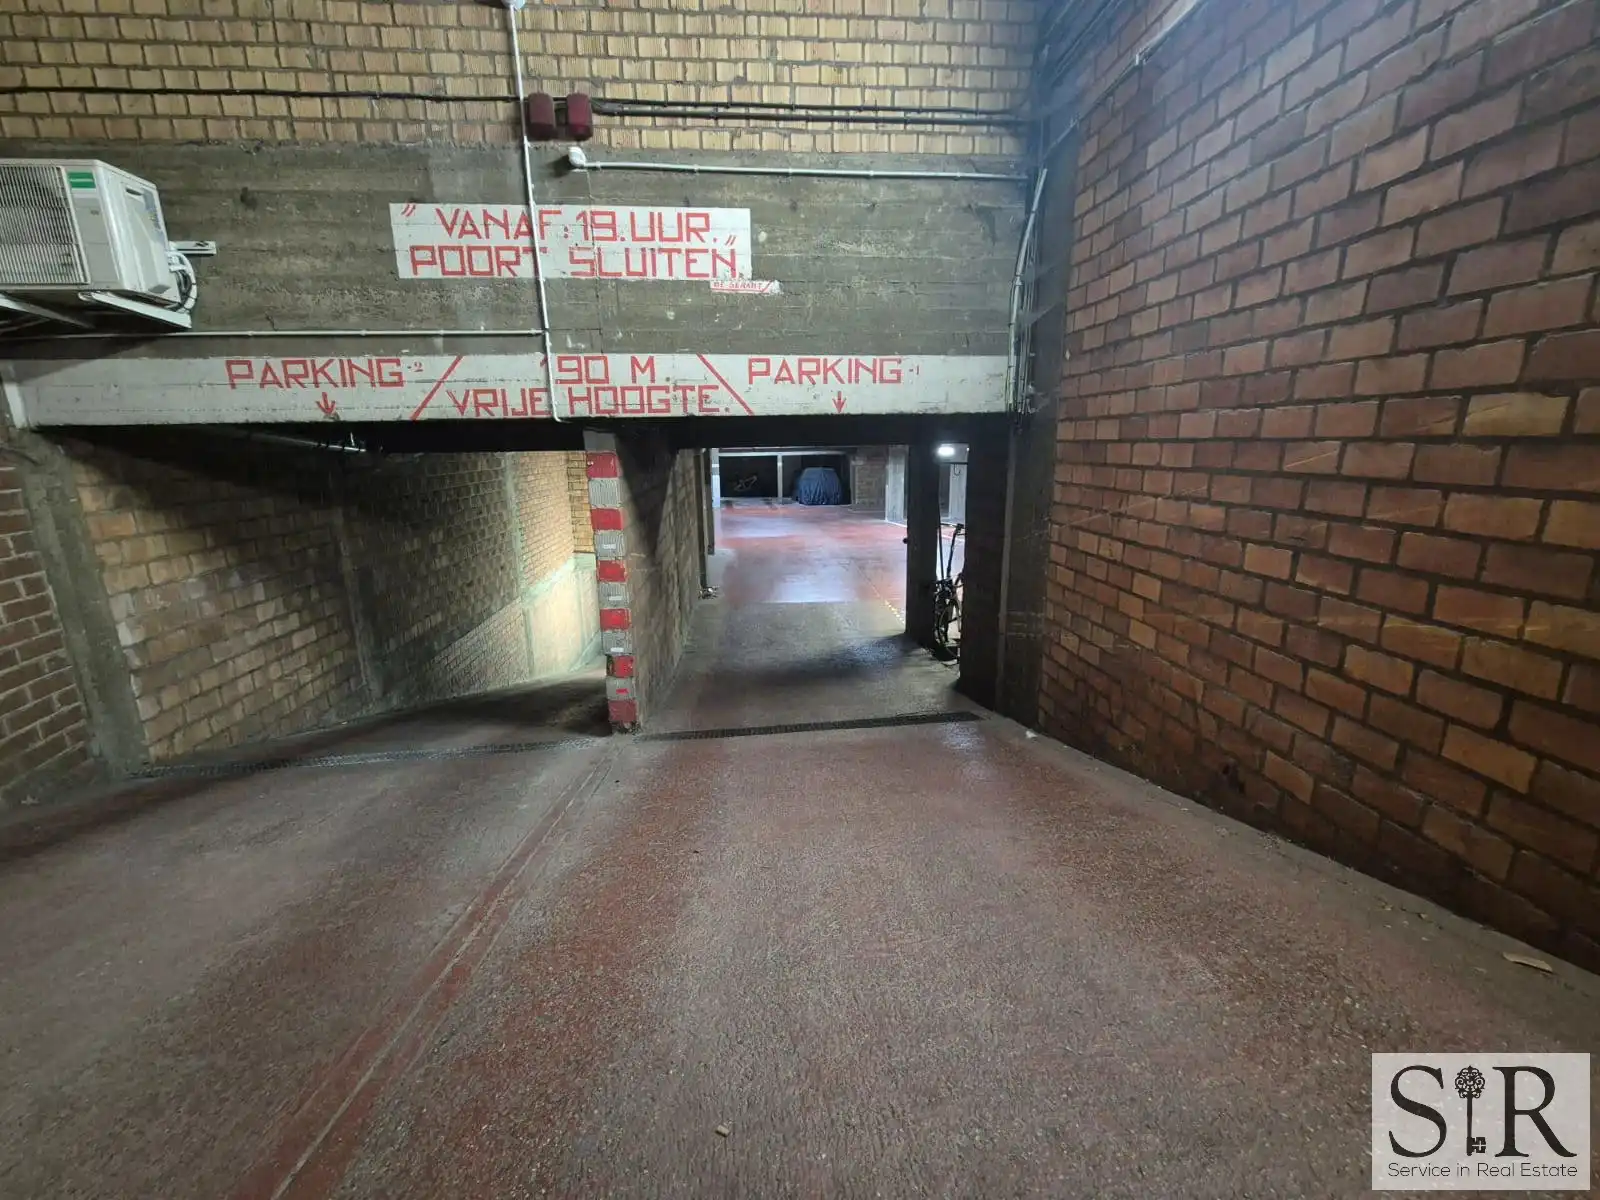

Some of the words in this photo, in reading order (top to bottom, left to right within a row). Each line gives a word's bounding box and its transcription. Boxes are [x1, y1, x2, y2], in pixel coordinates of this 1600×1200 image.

[409, 245, 548, 277] POORT
[225, 358, 405, 390] PARKING
[747, 357, 903, 385] PARKING
[445, 387, 553, 417] VRIJE
